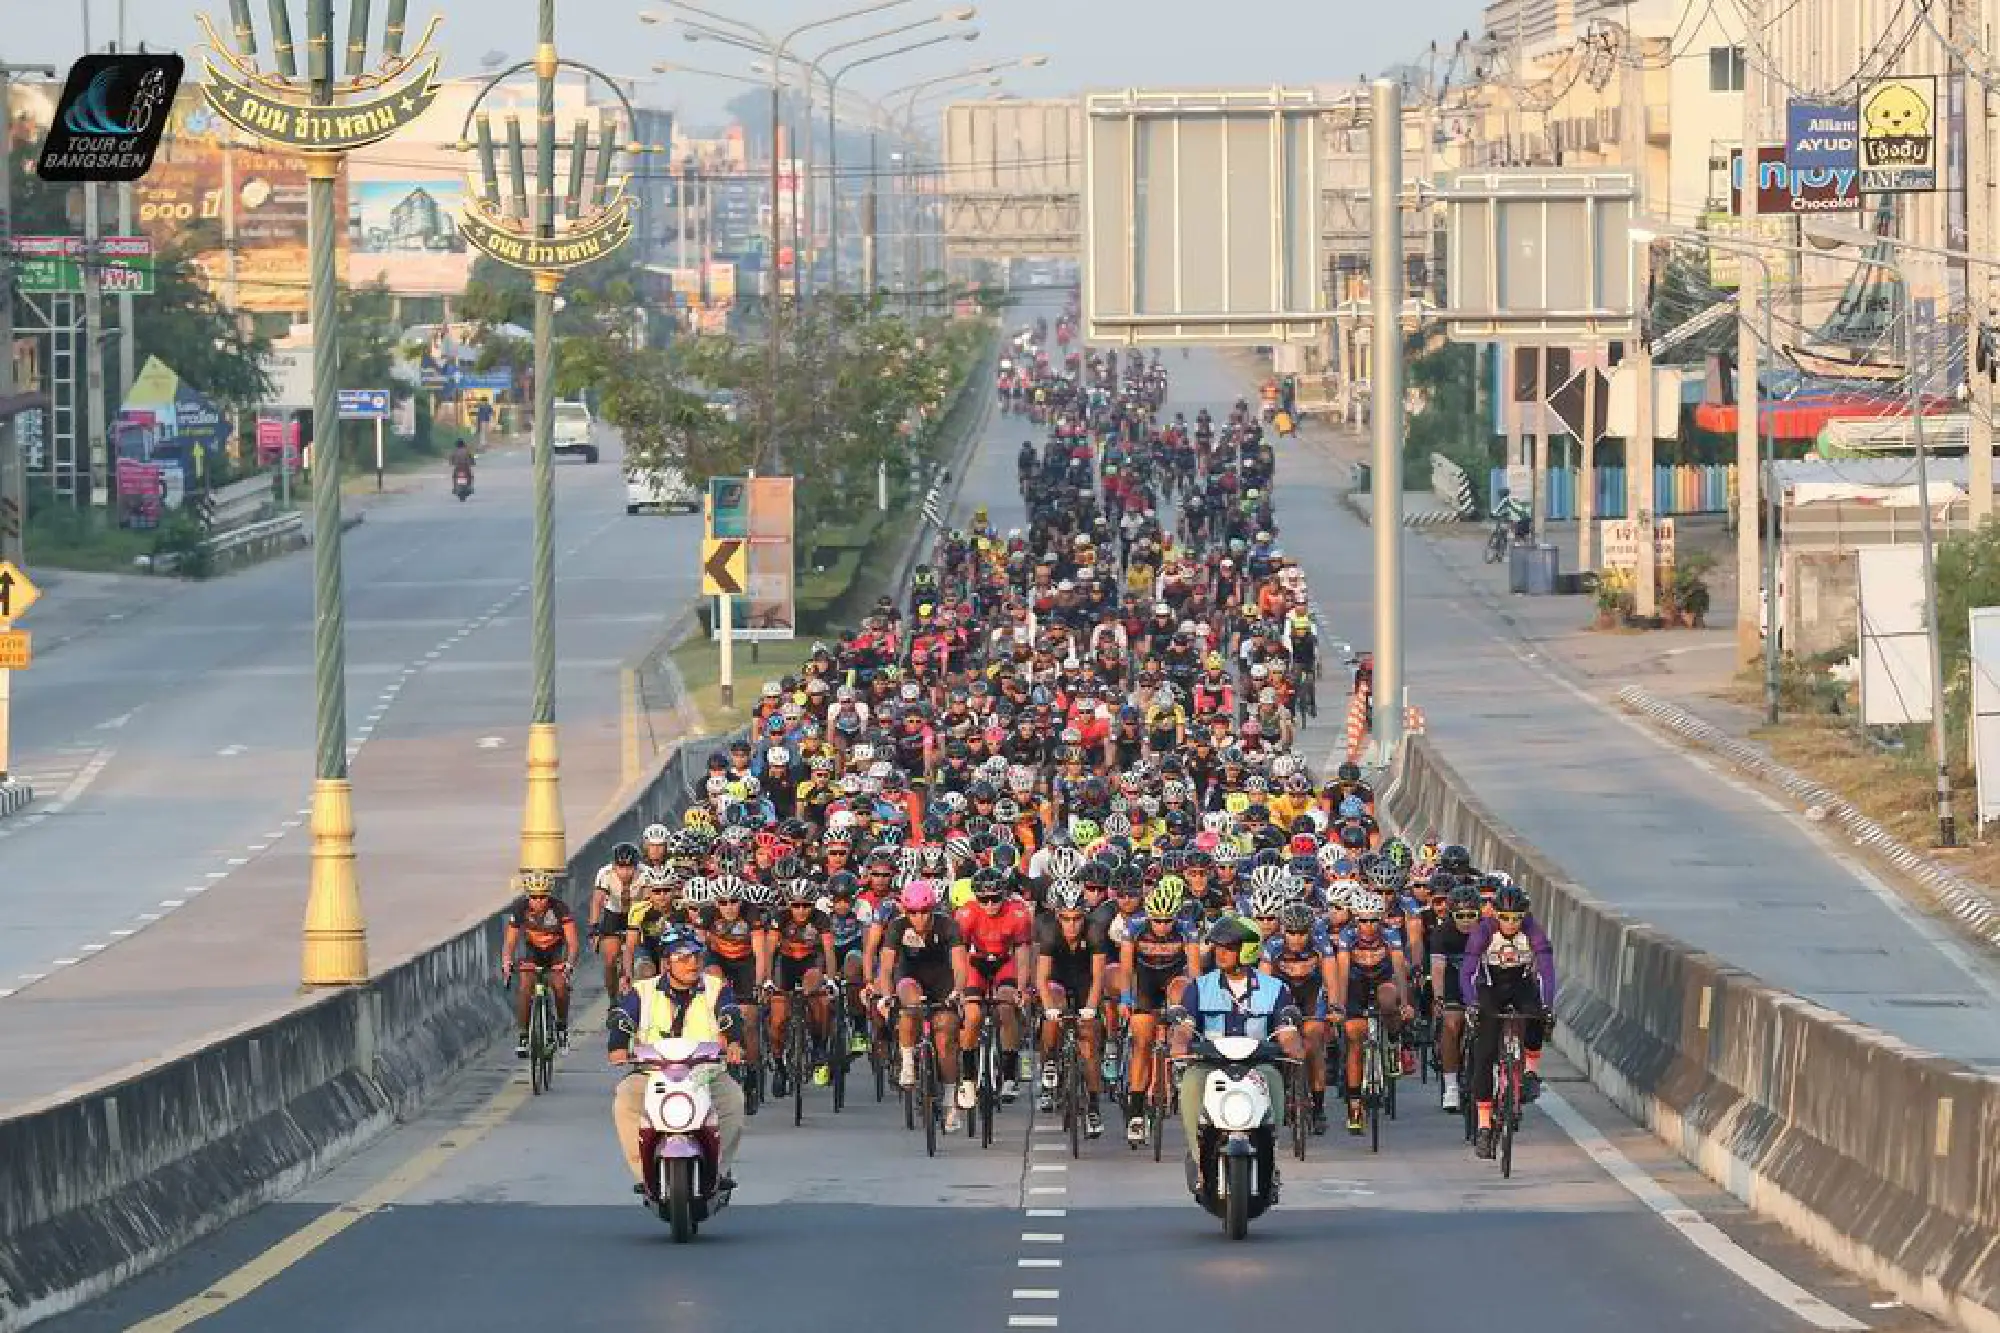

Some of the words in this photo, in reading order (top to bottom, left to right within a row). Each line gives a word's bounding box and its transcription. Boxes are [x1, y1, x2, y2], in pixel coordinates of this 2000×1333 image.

[239, 99, 289, 133] ถนน
[1807, 118, 1857, 132] Allian
[1796, 138, 1855, 151] AYUD
[1790, 197, 1859, 210] Chocolat
